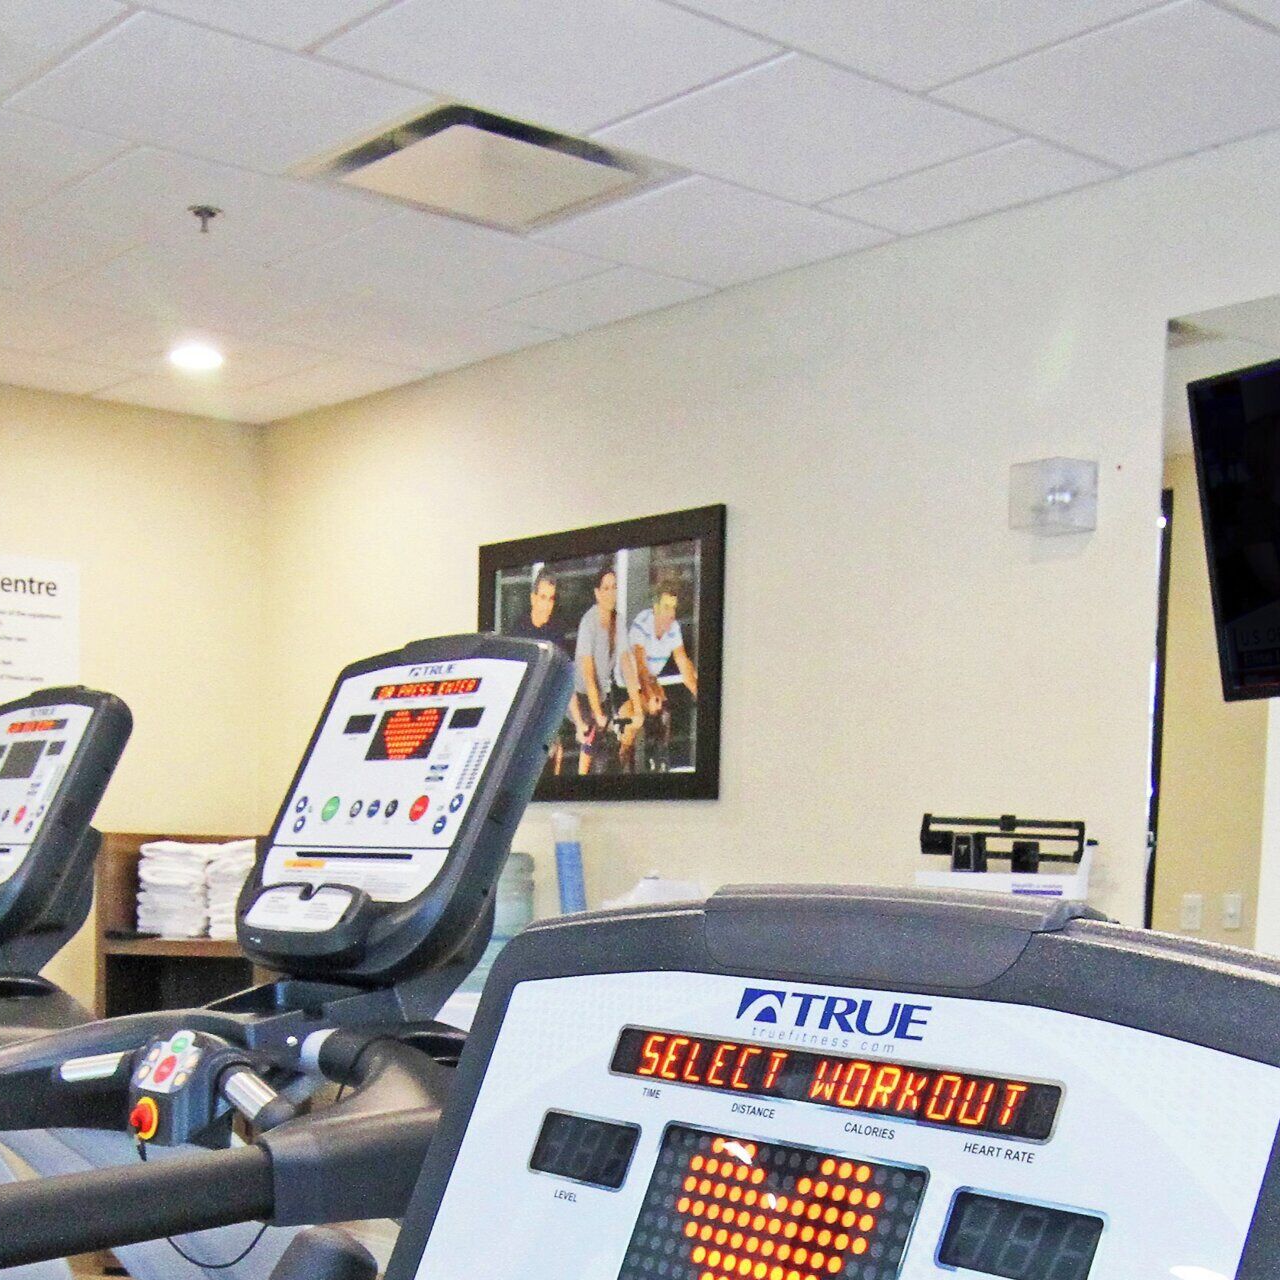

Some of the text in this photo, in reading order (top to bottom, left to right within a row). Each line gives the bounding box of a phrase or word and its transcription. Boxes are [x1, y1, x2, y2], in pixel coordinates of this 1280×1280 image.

[423, 664, 456, 676] TRUE
[790, 992, 933, 1041] TRUE
[637, 1034, 1028, 1126] SELECT WORKOUT
[642, 1087, 662, 1099] TIME
[731, 1102, 776, 1120] DISTANCE
[844, 1122, 896, 1140] CALORIES
[963, 1142, 1036, 1164] HEART RATE
[554, 1189, 577, 1203] LEVEL
